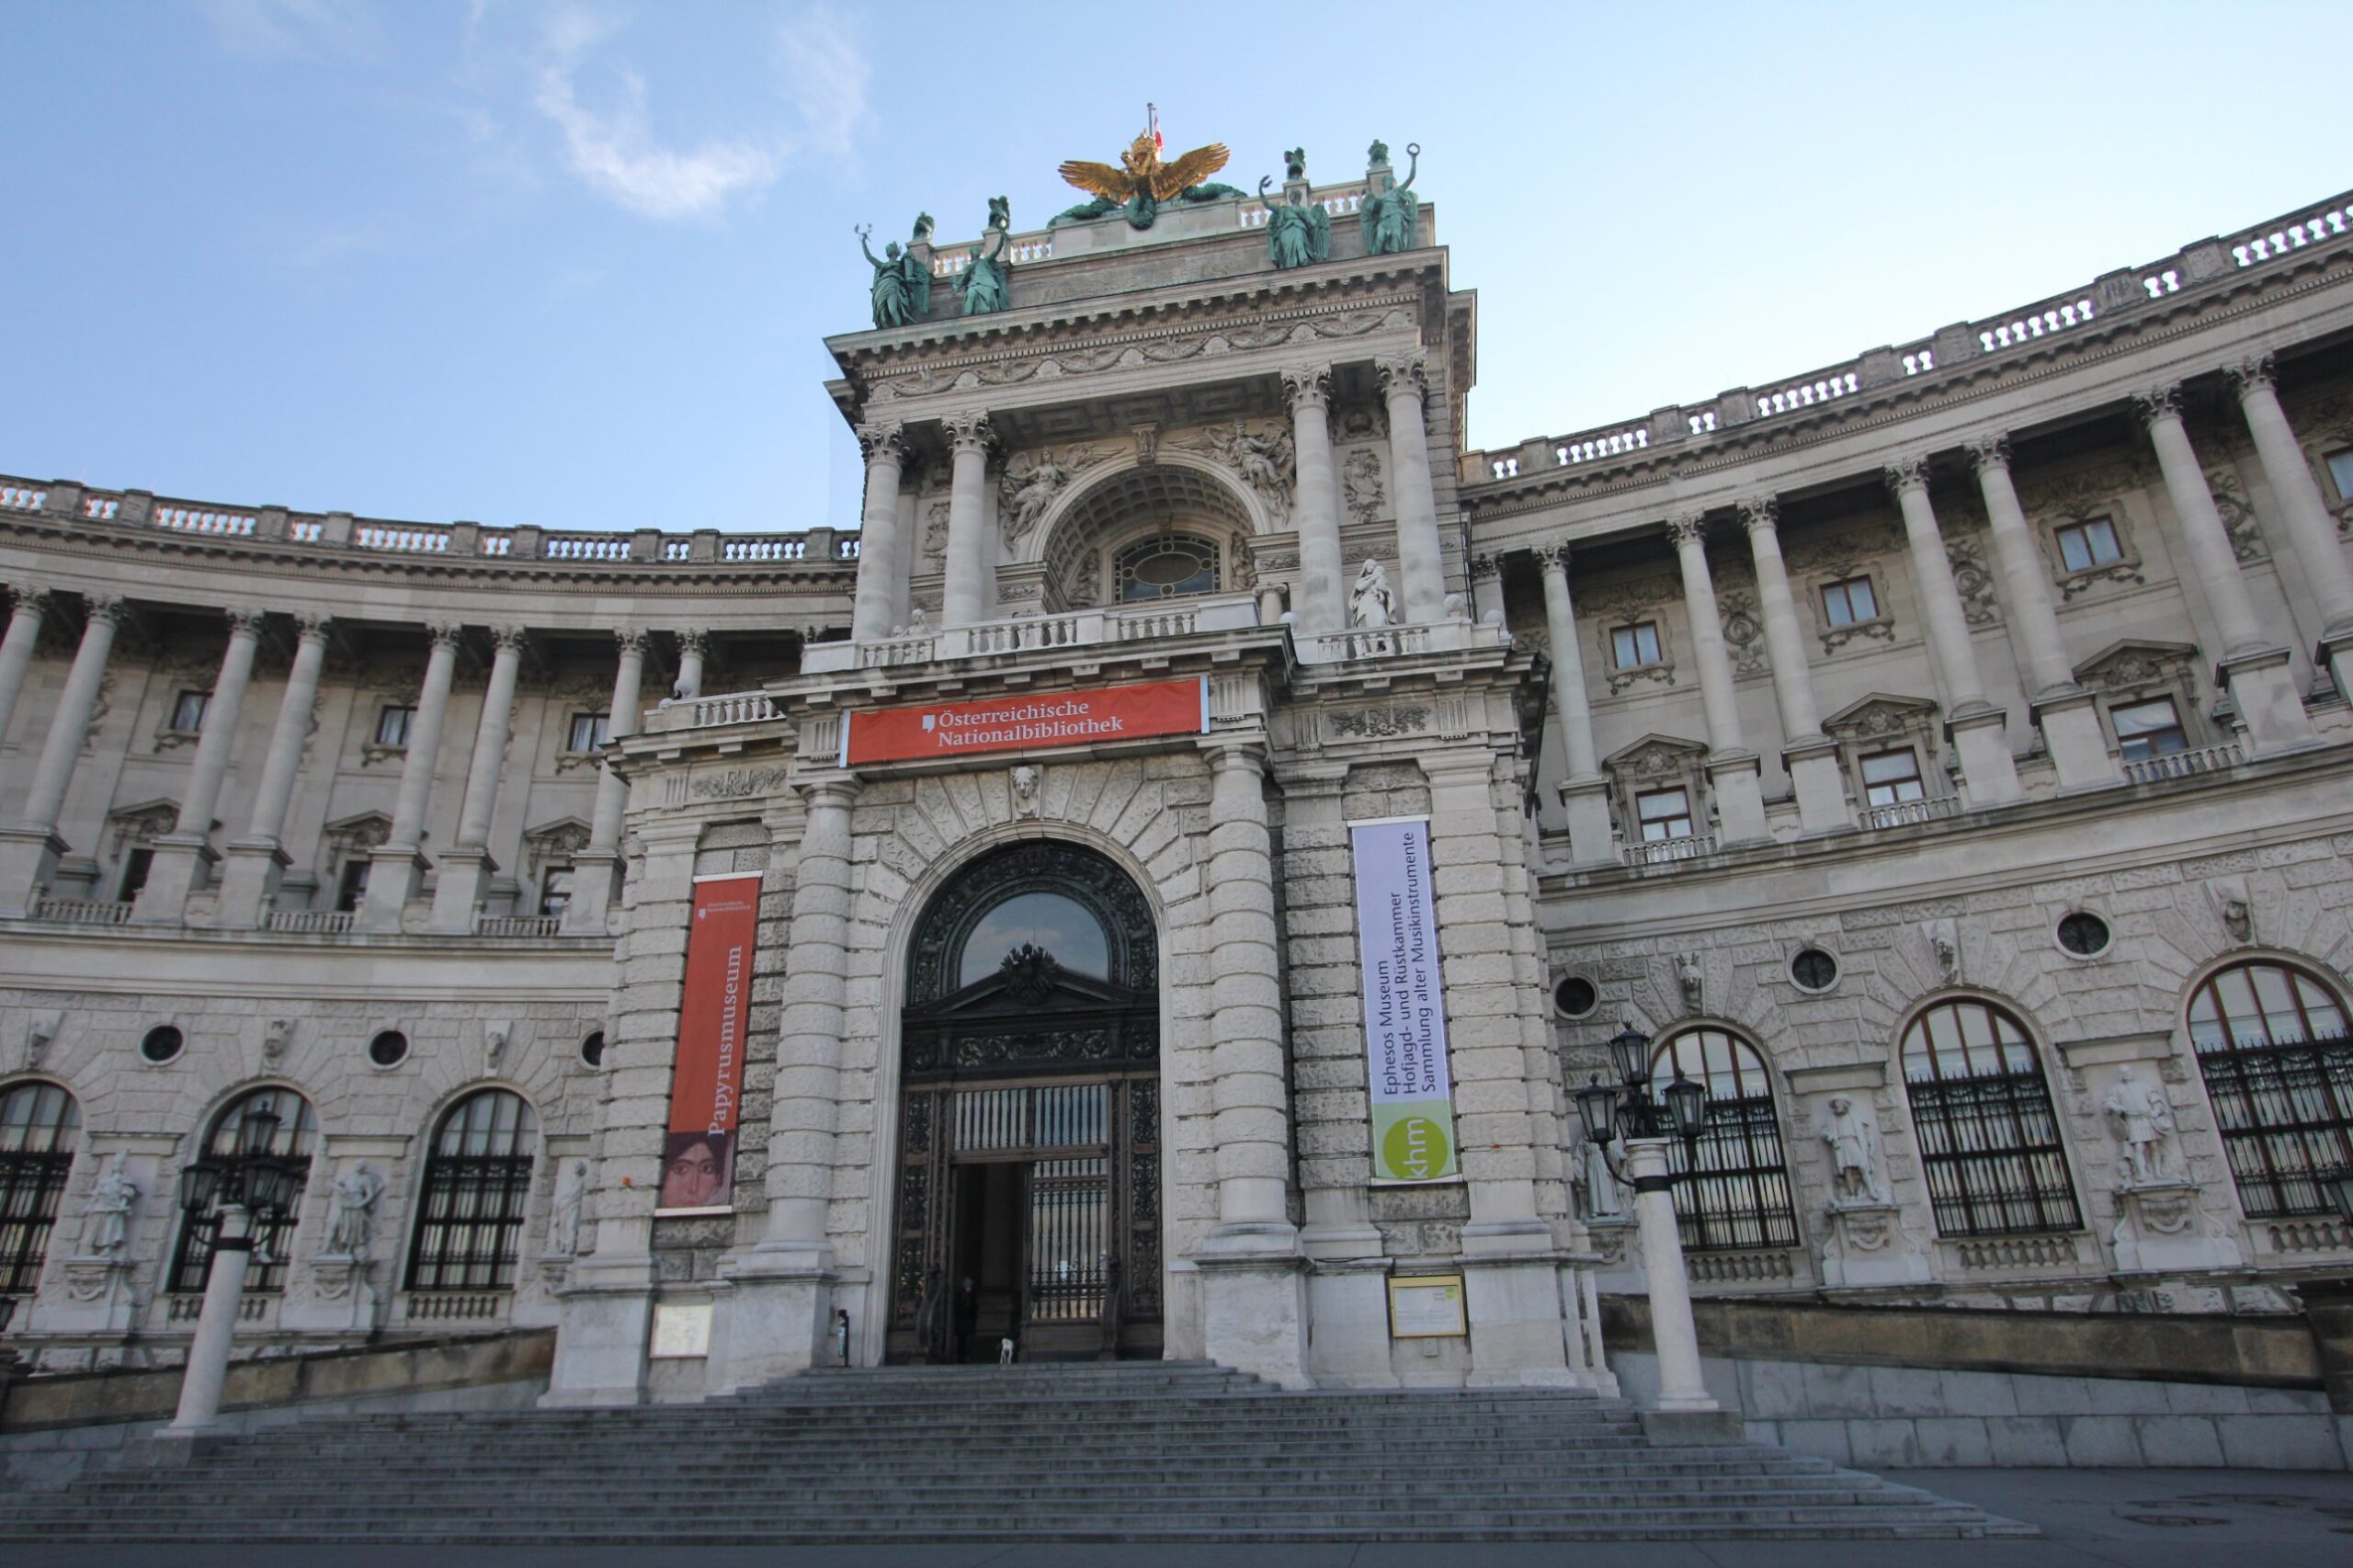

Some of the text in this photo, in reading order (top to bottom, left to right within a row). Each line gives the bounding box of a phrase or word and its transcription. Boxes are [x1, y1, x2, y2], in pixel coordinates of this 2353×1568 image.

[938, 700, 1090, 728] Österreichische
[938, 716, 1124, 747] Nationalbibliothek
[1378, 960, 1402, 1095] Ephesos Museum
[1391, 892, 1419, 1095] Hofjagd- und Rüstkammer
[1402, 832, 1436, 1093] Sammlung alter Musikinstrumente
[707, 945, 742, 1137] Papyrusmuseum
[1404, 1119, 1428, 1179] khm
